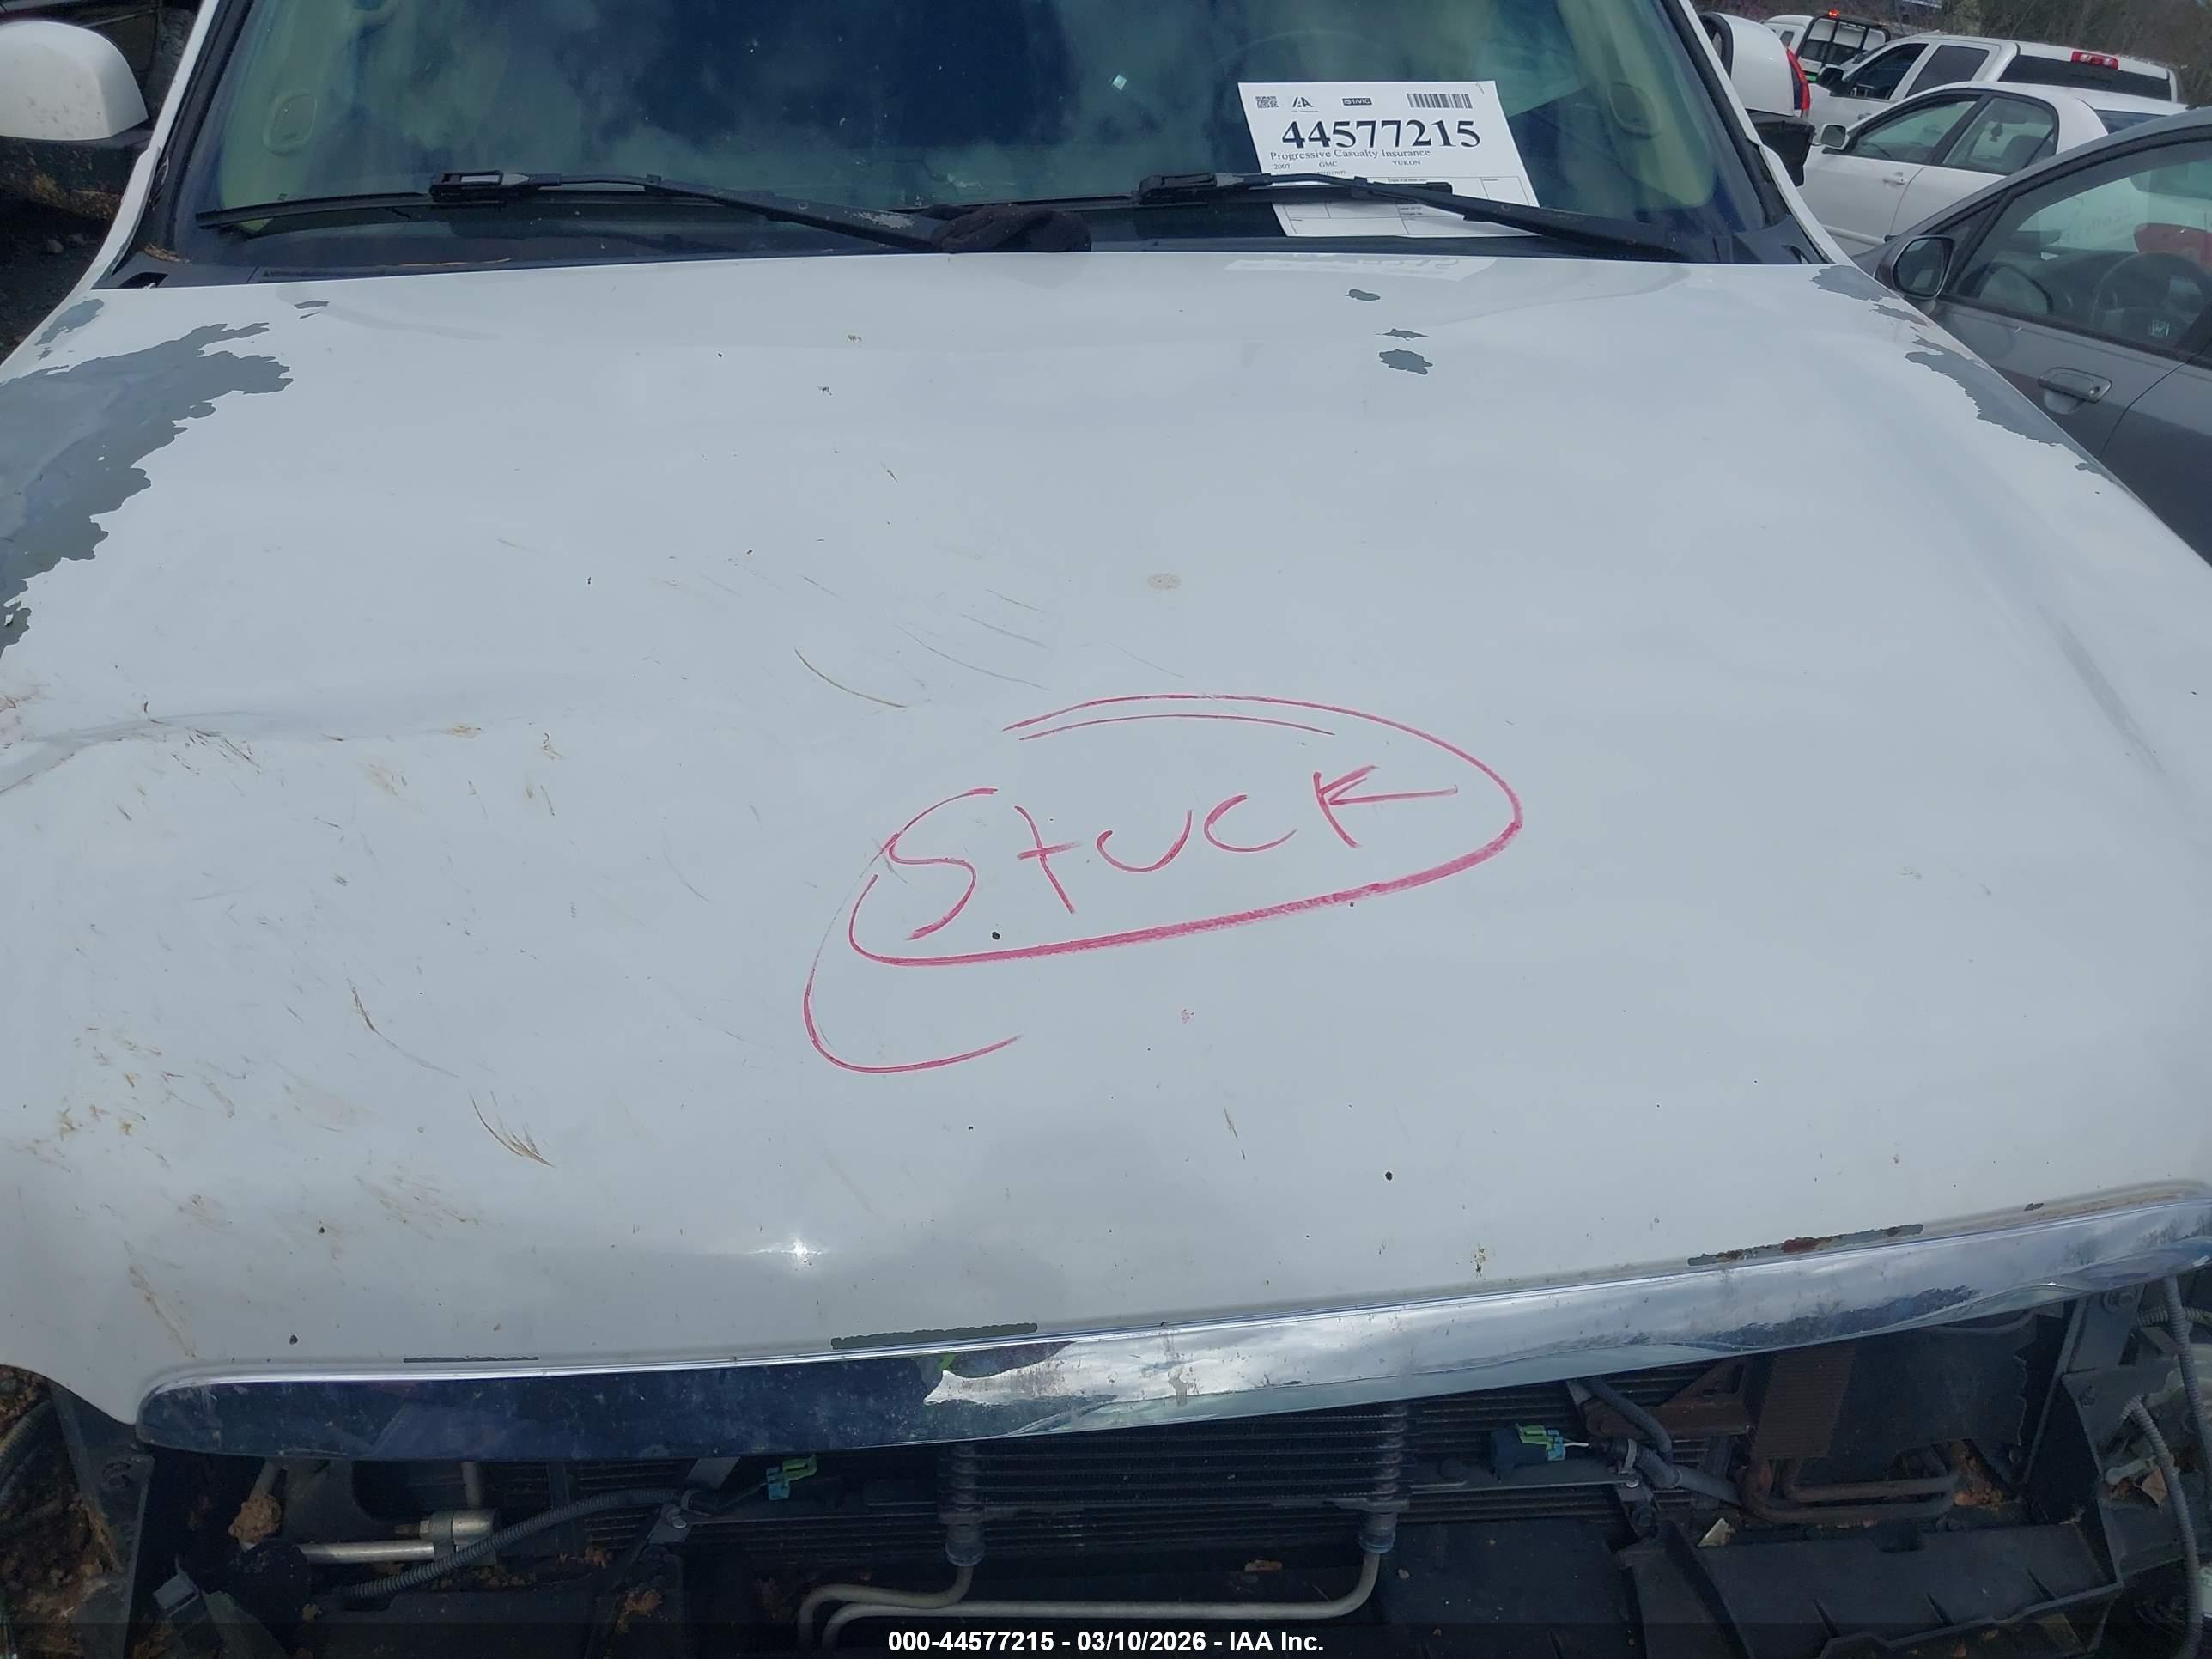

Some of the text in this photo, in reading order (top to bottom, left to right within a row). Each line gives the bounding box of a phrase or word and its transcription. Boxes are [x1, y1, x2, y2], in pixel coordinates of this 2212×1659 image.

[1282, 119, 1481, 149] 44577215
[1271, 149, 1431, 161] Progressive Casualty Insurance
